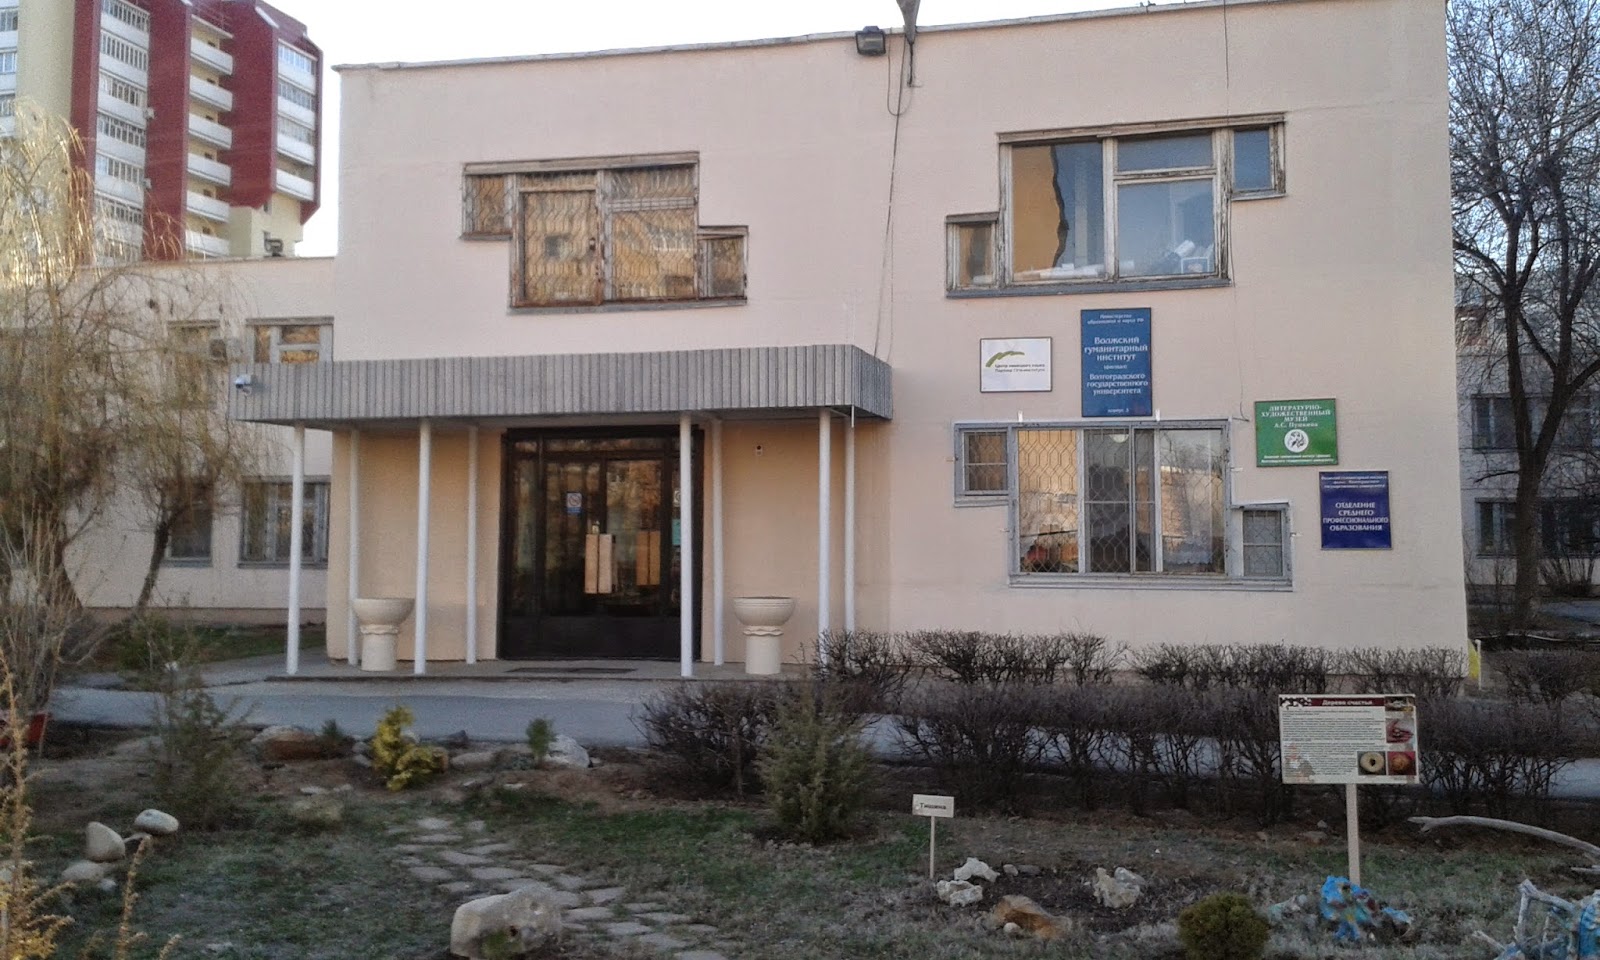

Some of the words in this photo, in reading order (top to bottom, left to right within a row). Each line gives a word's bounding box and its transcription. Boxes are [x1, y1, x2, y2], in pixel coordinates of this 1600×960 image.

[1094, 336, 1140, 345] Волжский
[1084, 344, 1148, 355] гуманитарный
[1096, 354, 1136, 362] институт
[1089, 373, 1146, 381] Волгоградского
[1086, 380, 1149, 389] государственного
[1093, 388, 1141, 396] университета
[1269, 404, 1322, 412] ЛИТЕРАТУРНО-
[1261, 409, 1331, 418] ХУДОЖЕСТВЕННЫЙ
